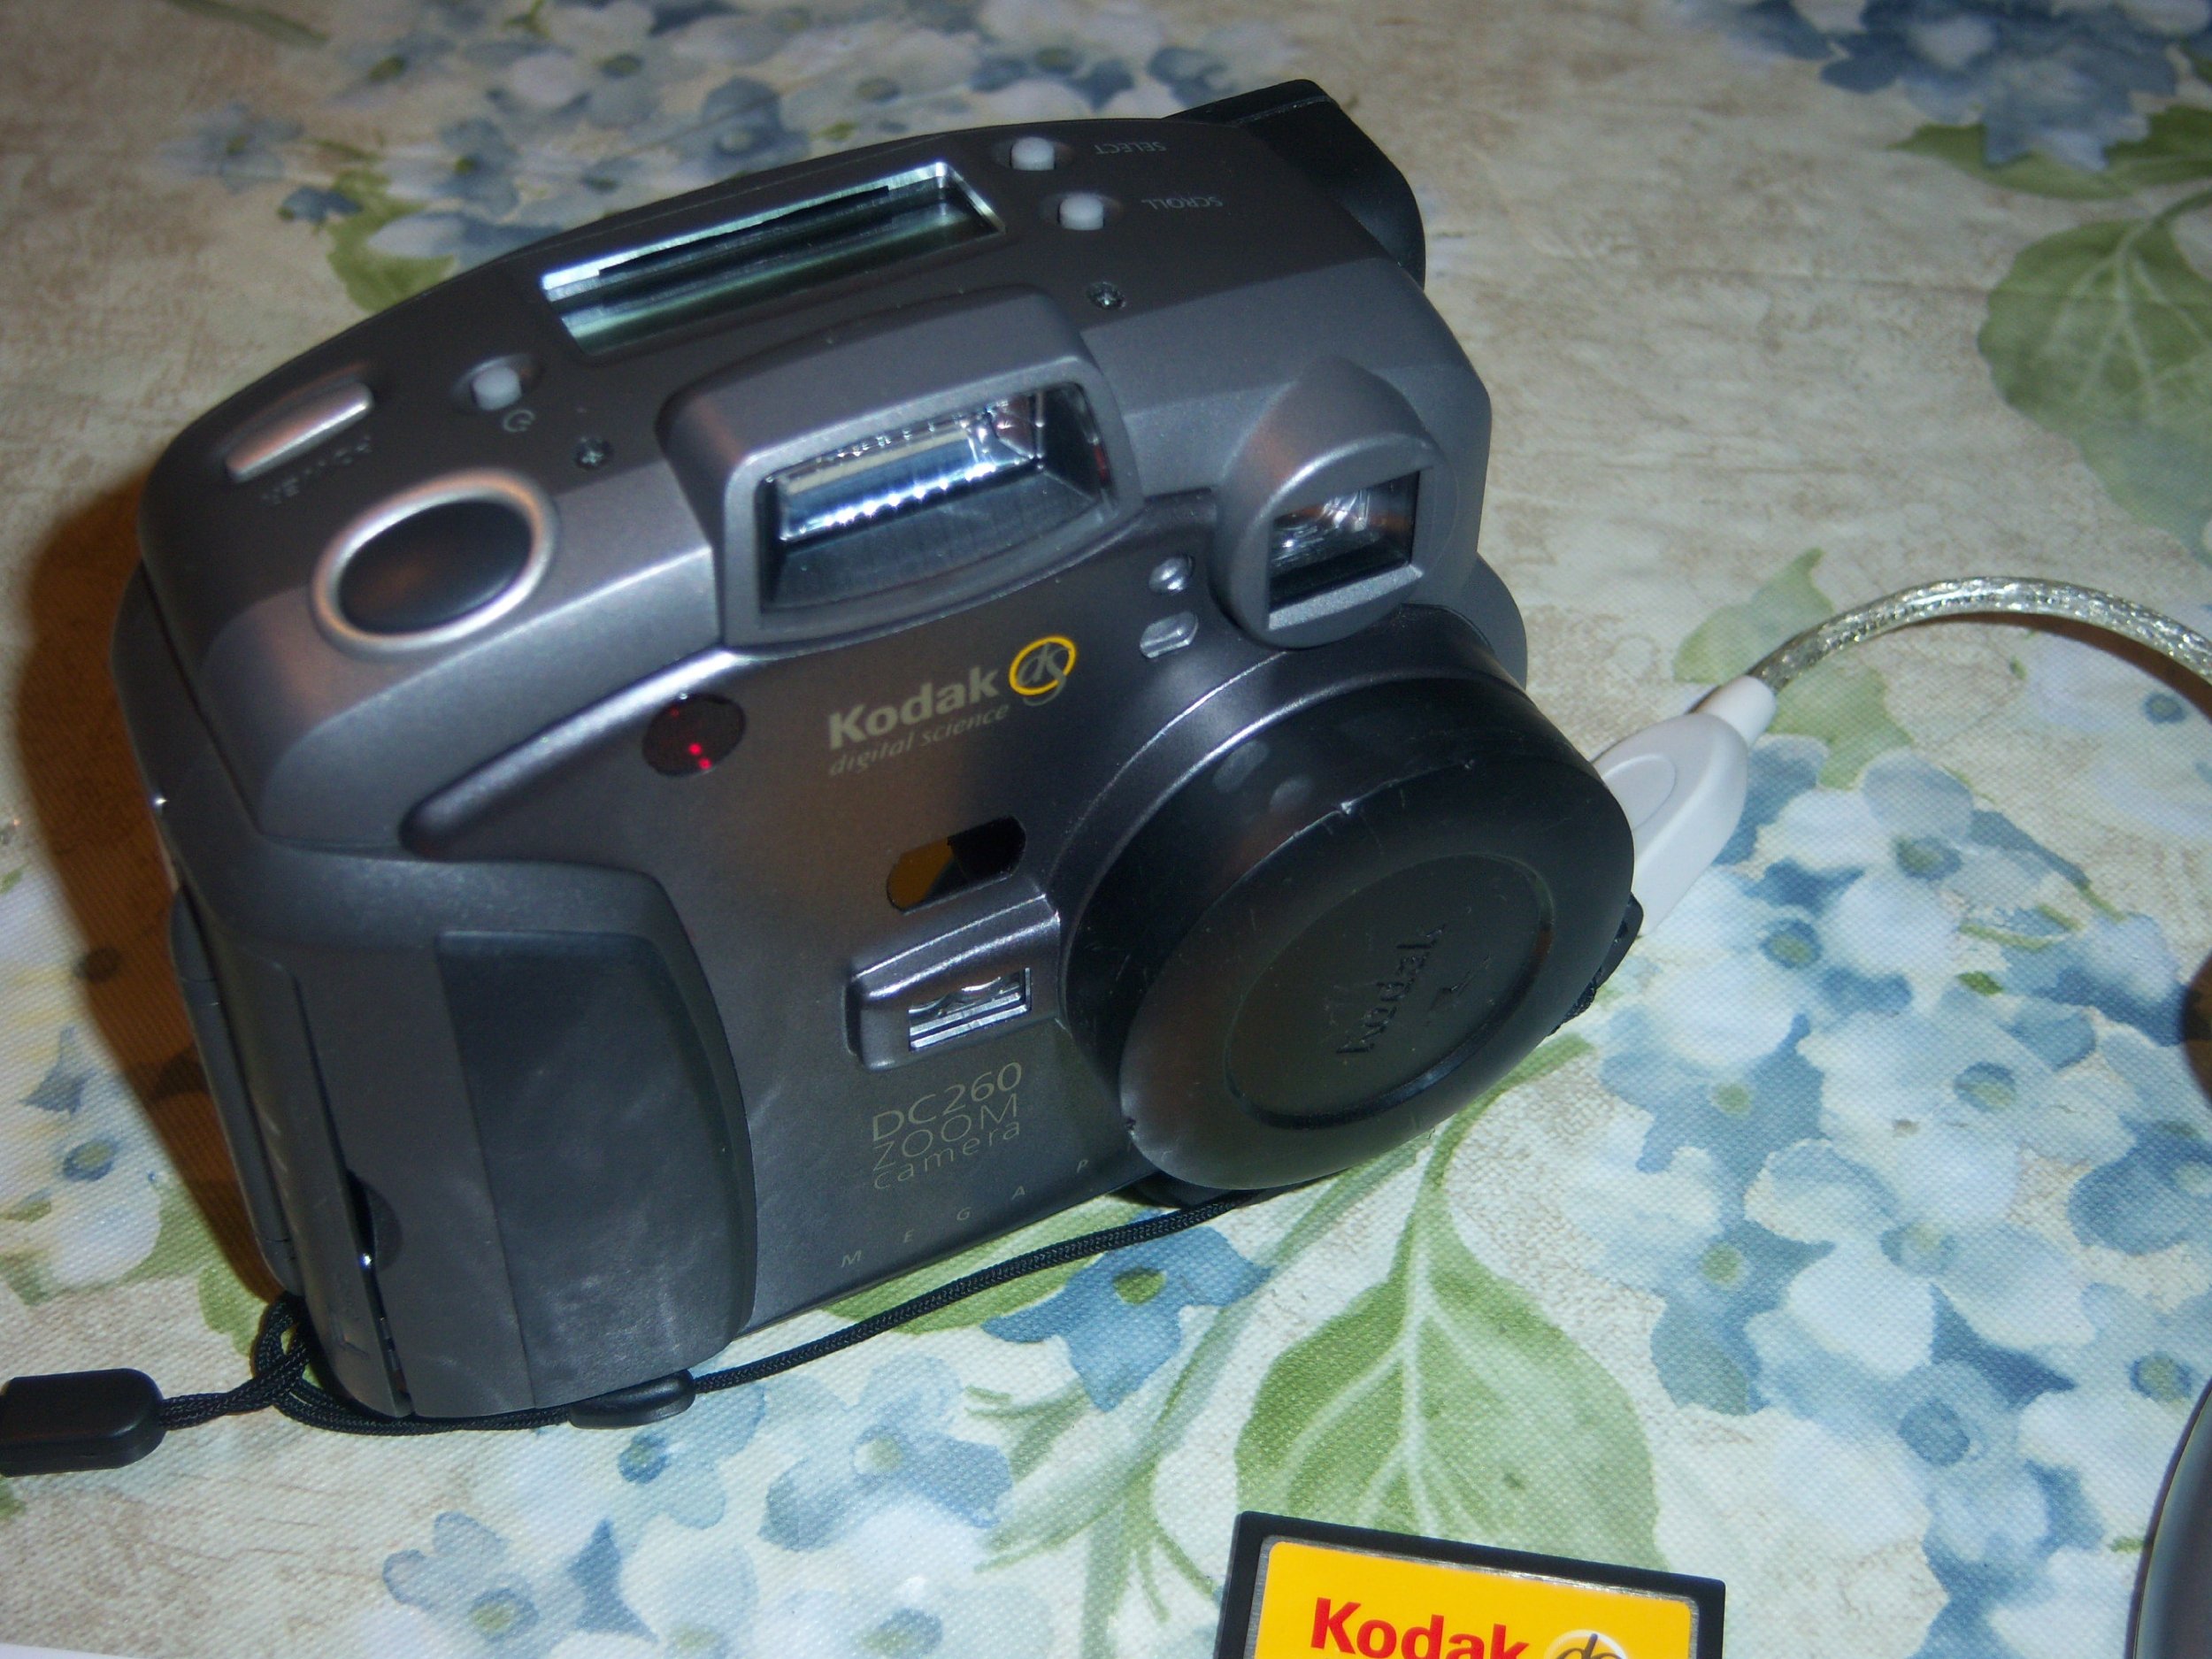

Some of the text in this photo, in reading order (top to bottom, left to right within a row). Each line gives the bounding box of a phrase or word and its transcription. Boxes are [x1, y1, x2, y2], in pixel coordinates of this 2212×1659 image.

[1094, 141, 1167, 155] SELECT
[1141, 196, 1224, 211] SCROLL
[828, 667, 1000, 749] Kodak
[829, 703, 1010, 777] digital science
[872, 1062, 1023, 1142] DC260
[872, 1093, 1018, 1172] ZOOM
[874, 1120, 1020, 1190] camera
[1310, 1596, 1530, 1659] Kodak
